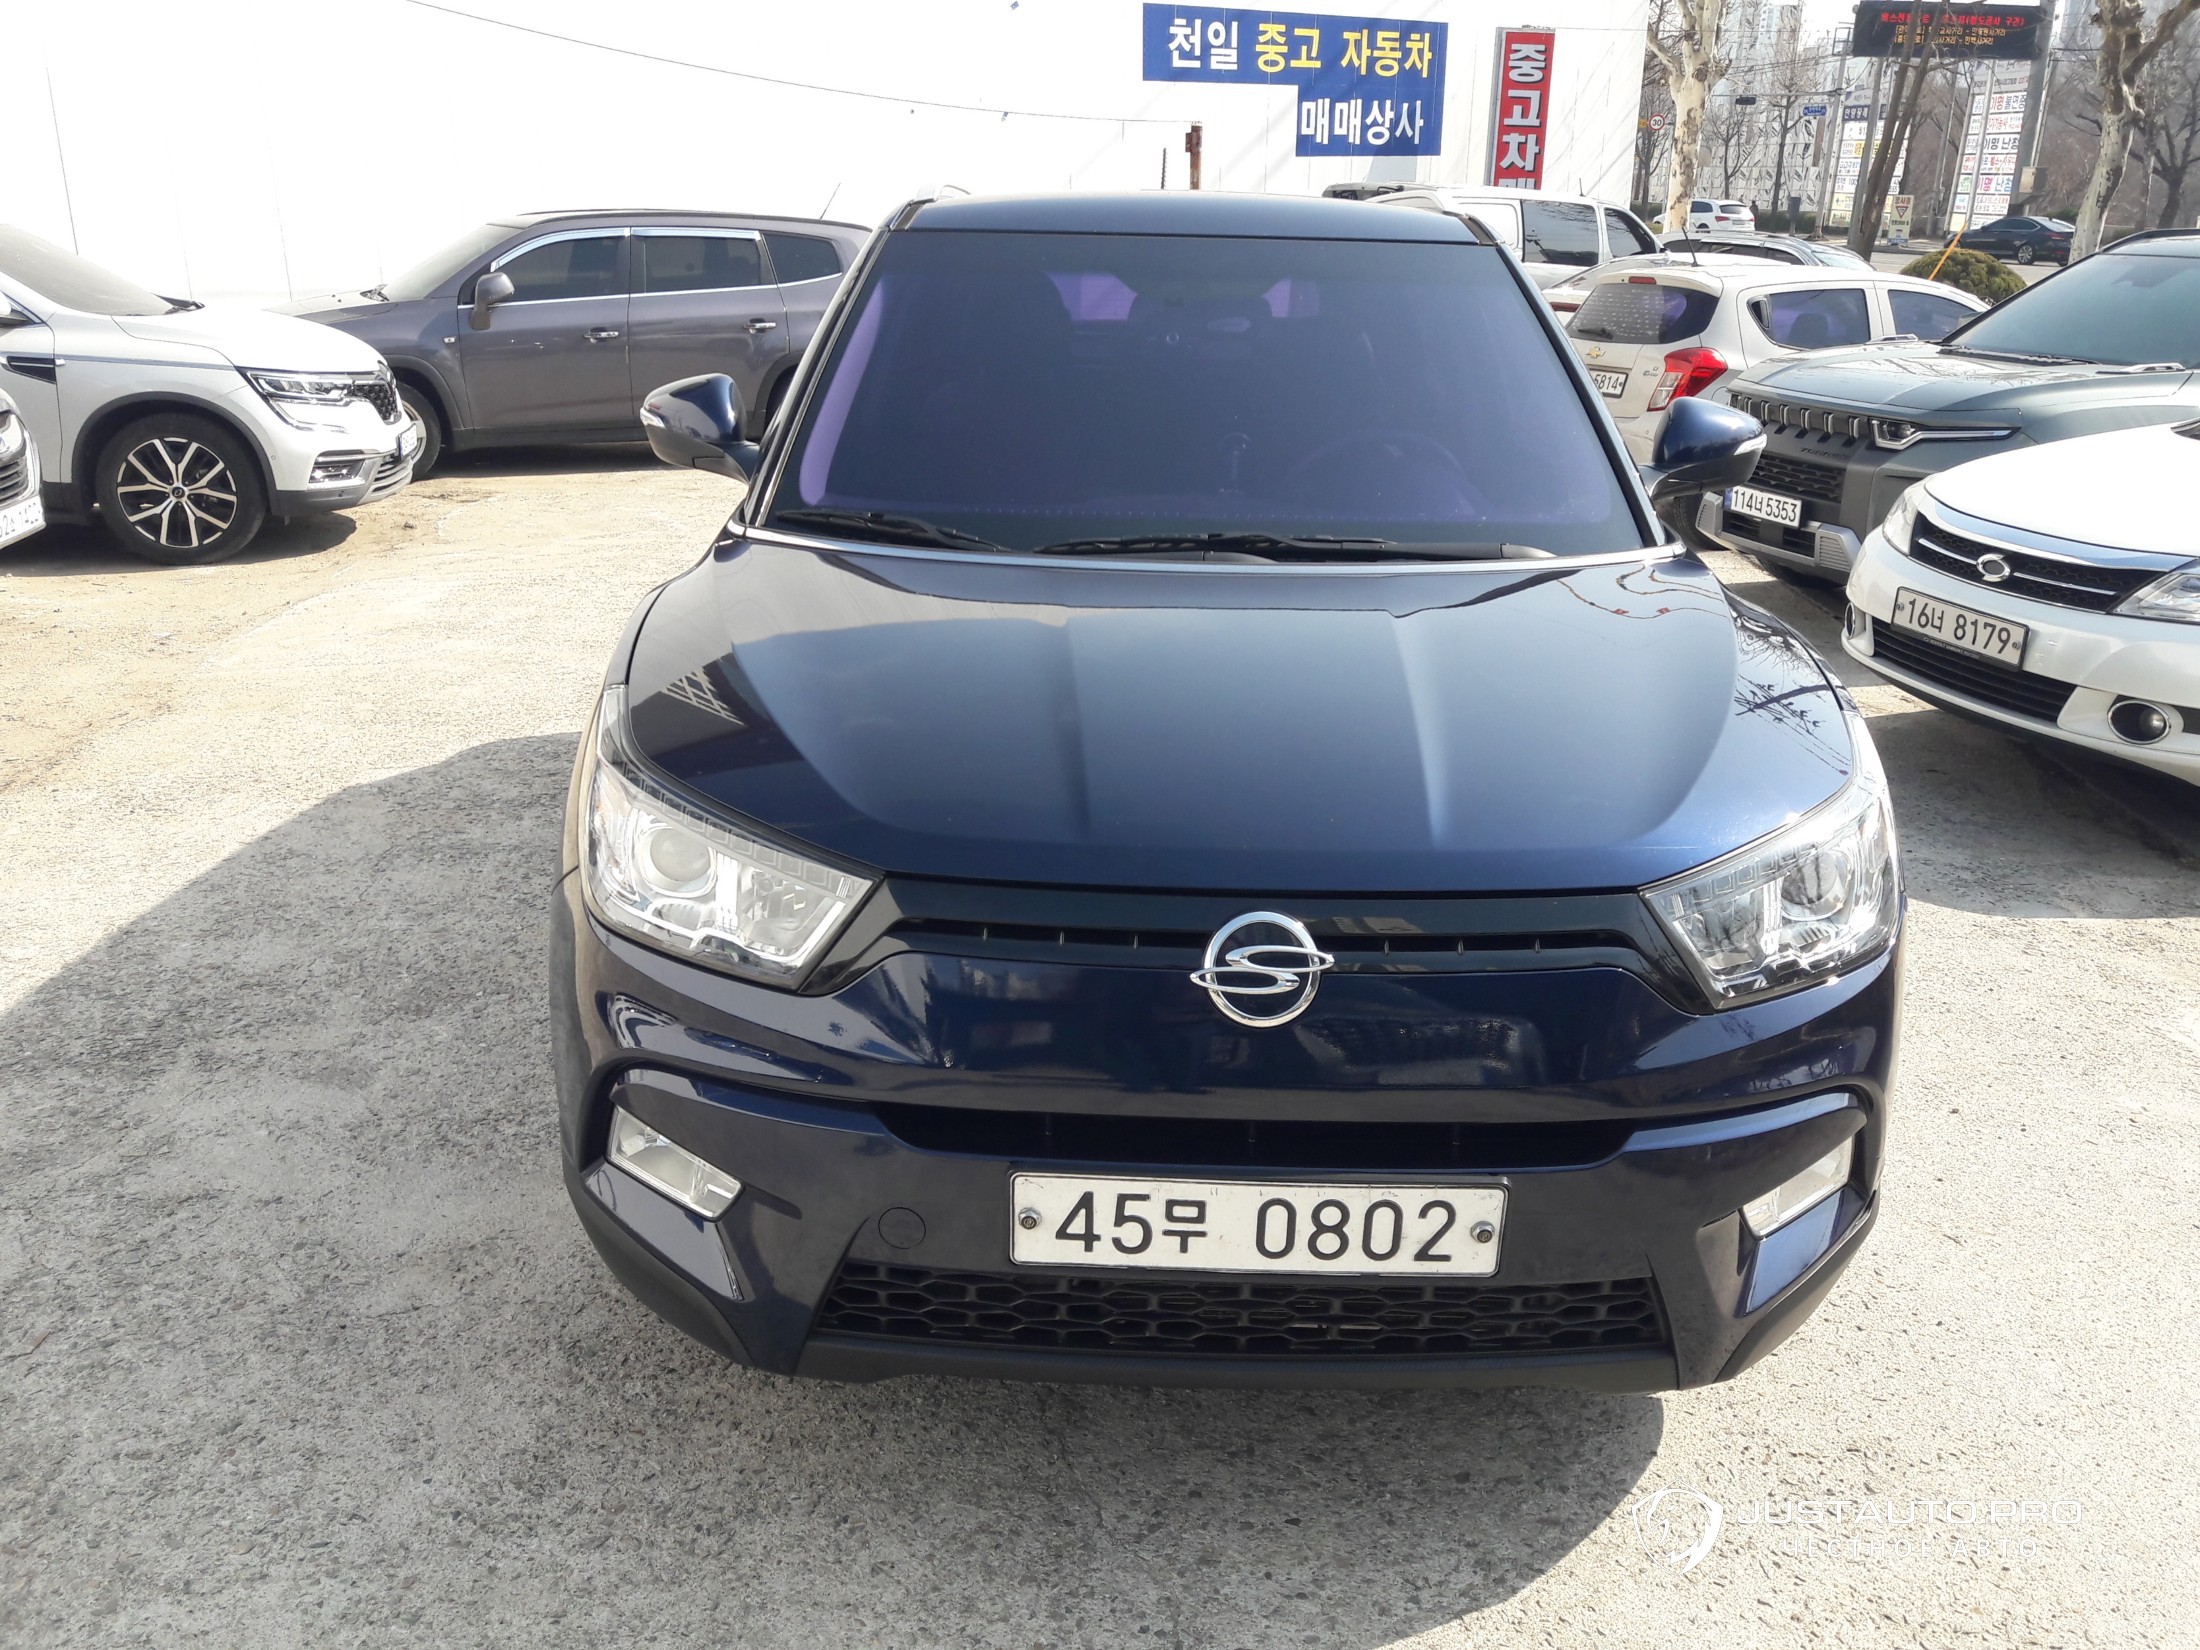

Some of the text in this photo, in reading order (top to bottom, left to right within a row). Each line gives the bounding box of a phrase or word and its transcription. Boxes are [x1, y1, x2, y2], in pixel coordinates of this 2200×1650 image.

[1168, 18, 1433, 79] 천일 중고 자동차
[1301, 98, 1424, 145] 매매상사
[1734, 488, 1797, 522] 114너 5353
[1908, 598, 1944, 633] 16너
[1953, 613, 2011, 655] 8179
[1055, 1190, 1457, 1263] 45무 0802
